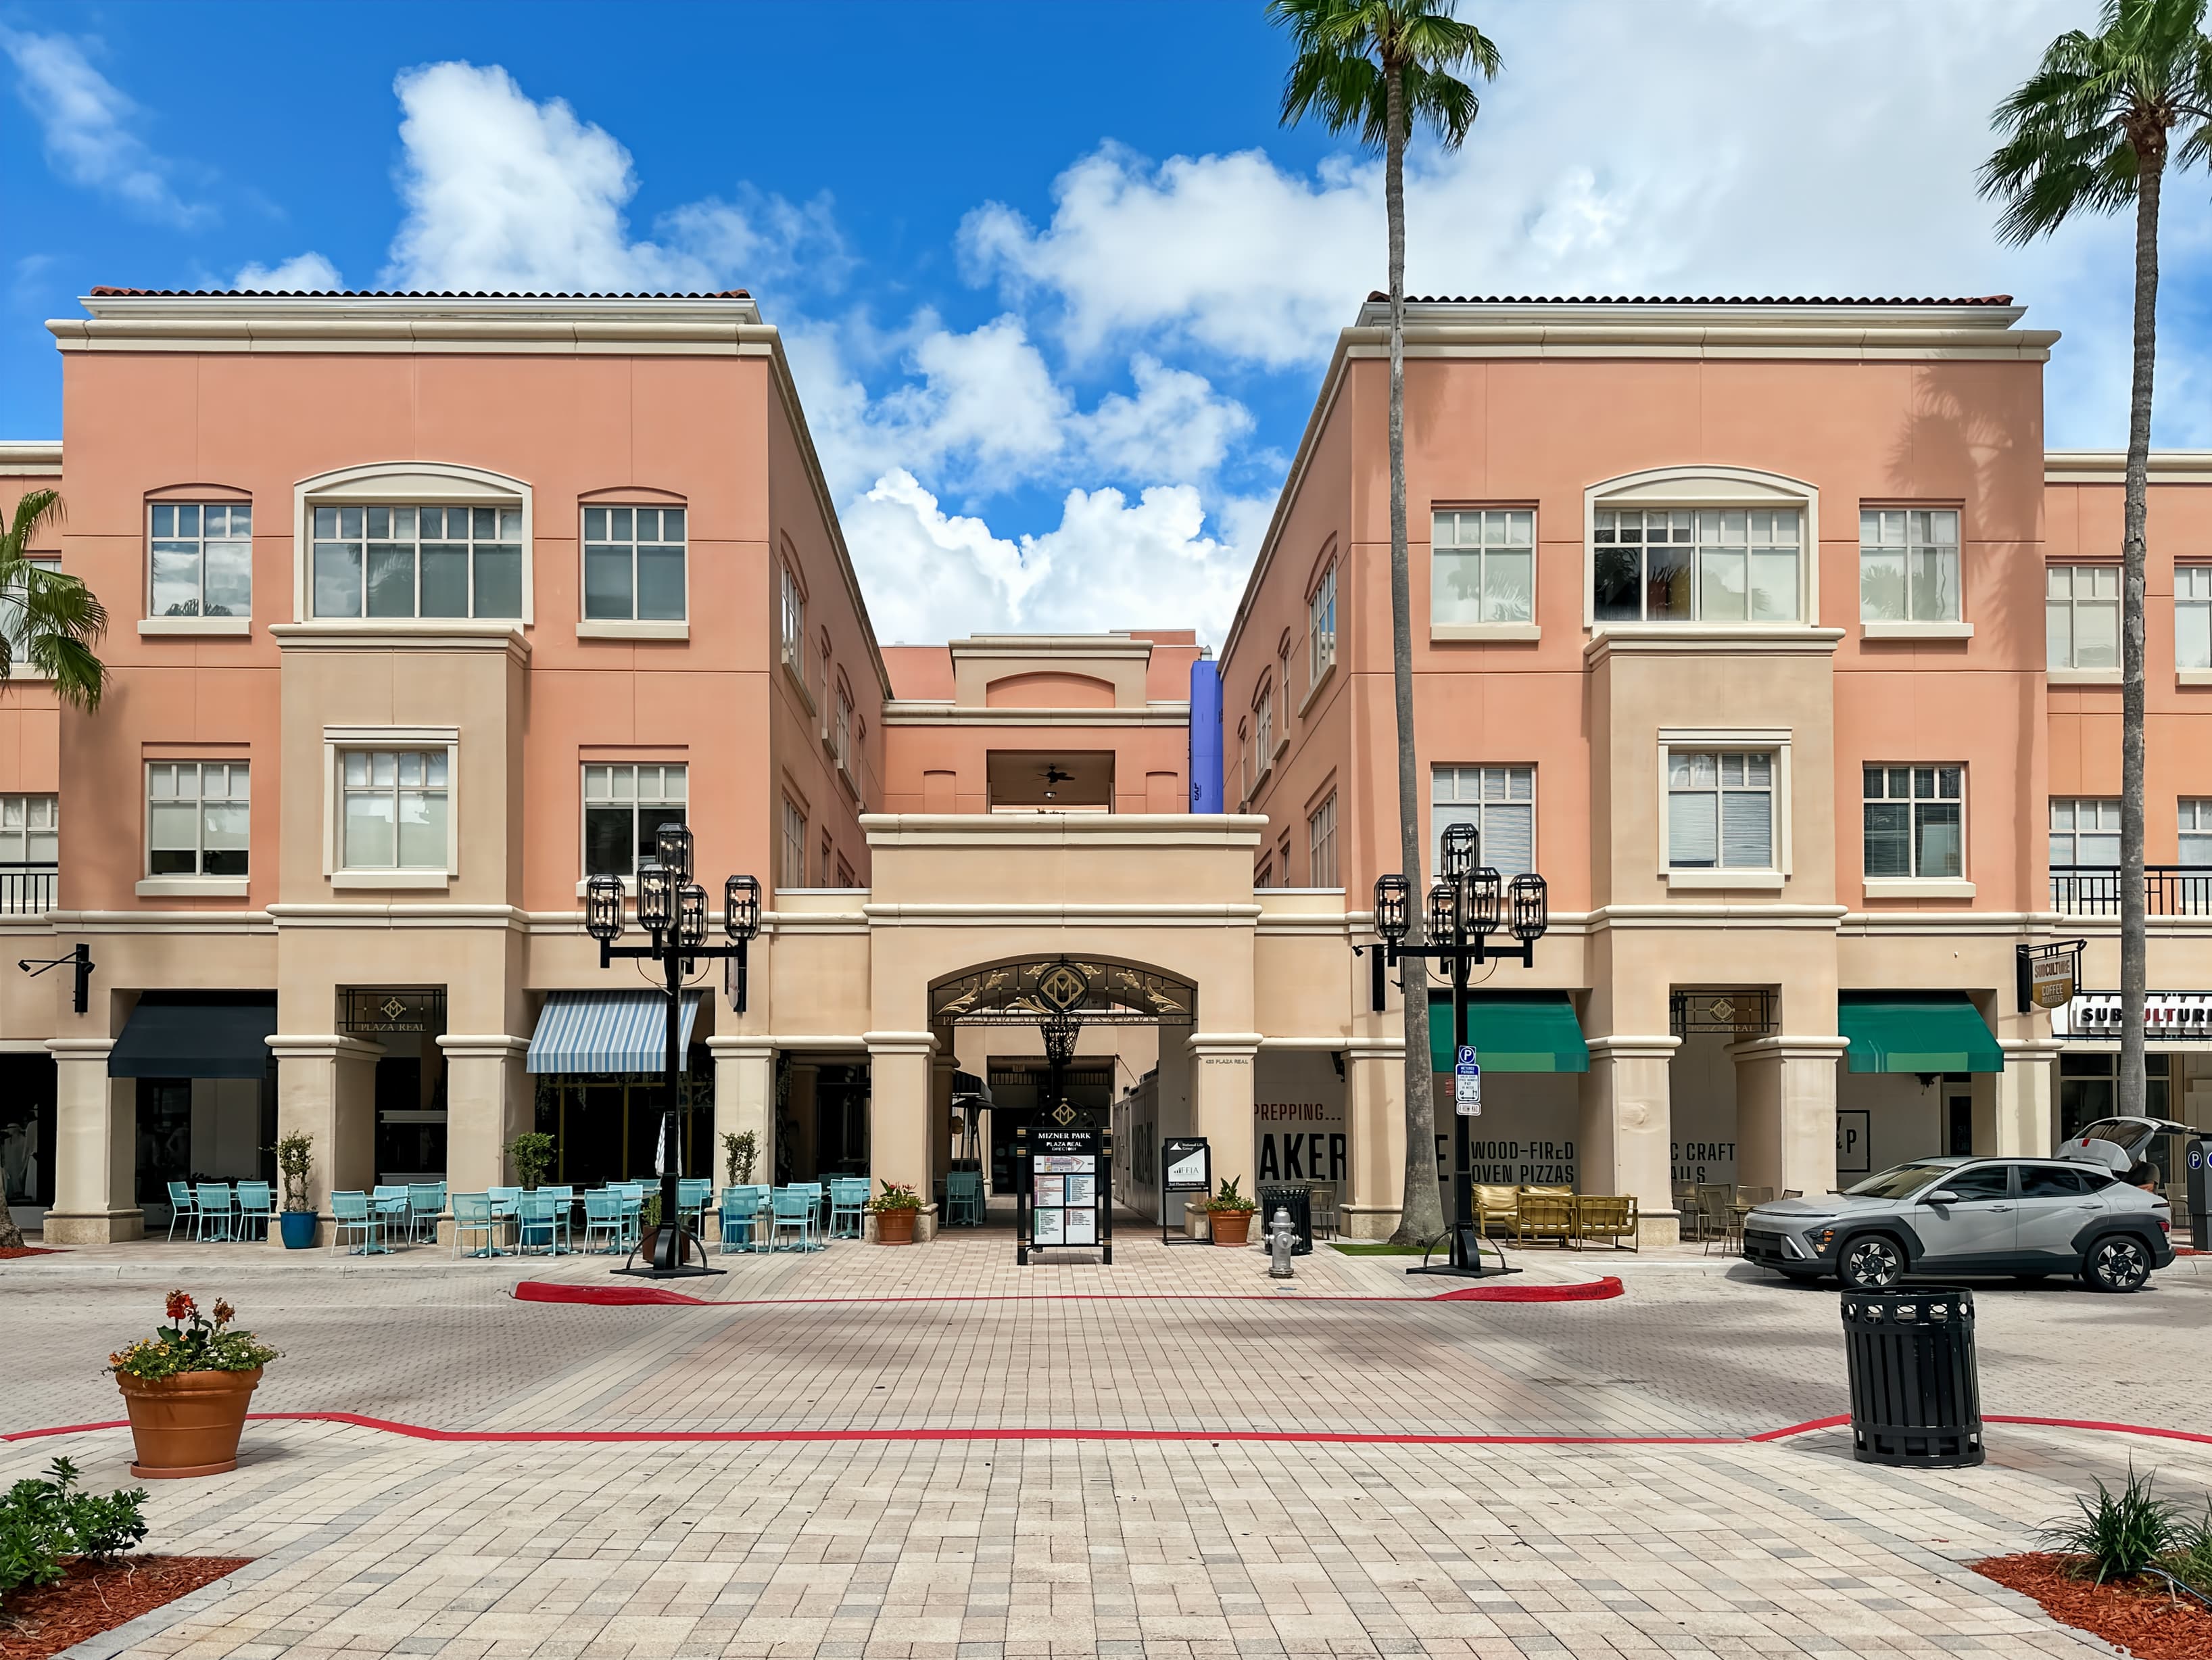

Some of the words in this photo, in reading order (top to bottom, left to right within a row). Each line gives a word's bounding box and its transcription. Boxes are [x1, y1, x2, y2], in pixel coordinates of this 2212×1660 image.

[2035, 960, 2070, 978] SUBCULTURE
[2042, 983, 2063, 996] COFFEE
[2042, 995, 2063, 1003] ROASTERS
[361, 1023, 394, 1031] PLAZA
[399, 1023, 427, 1031] REAL
[1464, 1049, 1472, 1061] P
[1254, 1104, 1341, 1120] PREPPING...
[1471, 1141, 1574, 1160] WOOD-FIRED
[1686, 1143, 1735, 1161] CRAFT
[1472, 1164, 1512, 1183] OVEN
[1520, 1164, 1574, 1183] PIZZAS
